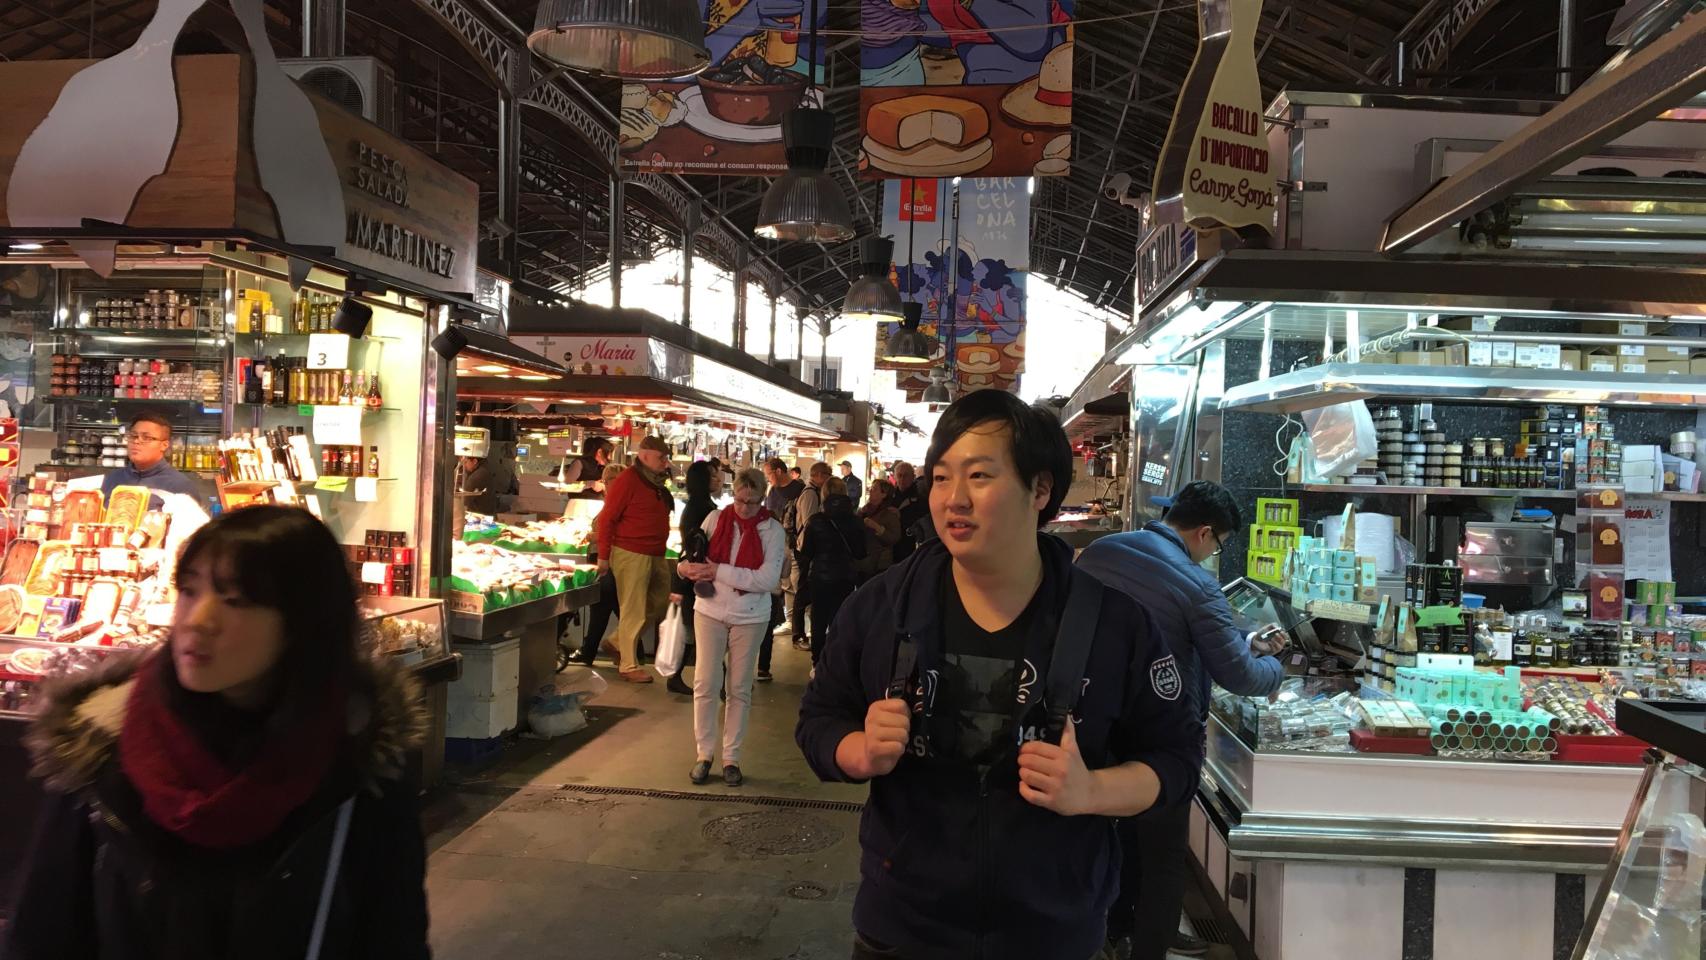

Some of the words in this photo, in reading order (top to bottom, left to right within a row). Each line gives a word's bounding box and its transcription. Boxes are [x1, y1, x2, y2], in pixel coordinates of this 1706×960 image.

[1212, 102, 1258, 136] BACALLA
[756, 163, 788, 171] responsa
[1190, 168, 1236, 203] Carme
[317, 352, 327, 366] 3
[581, 339, 637, 361] Maria
